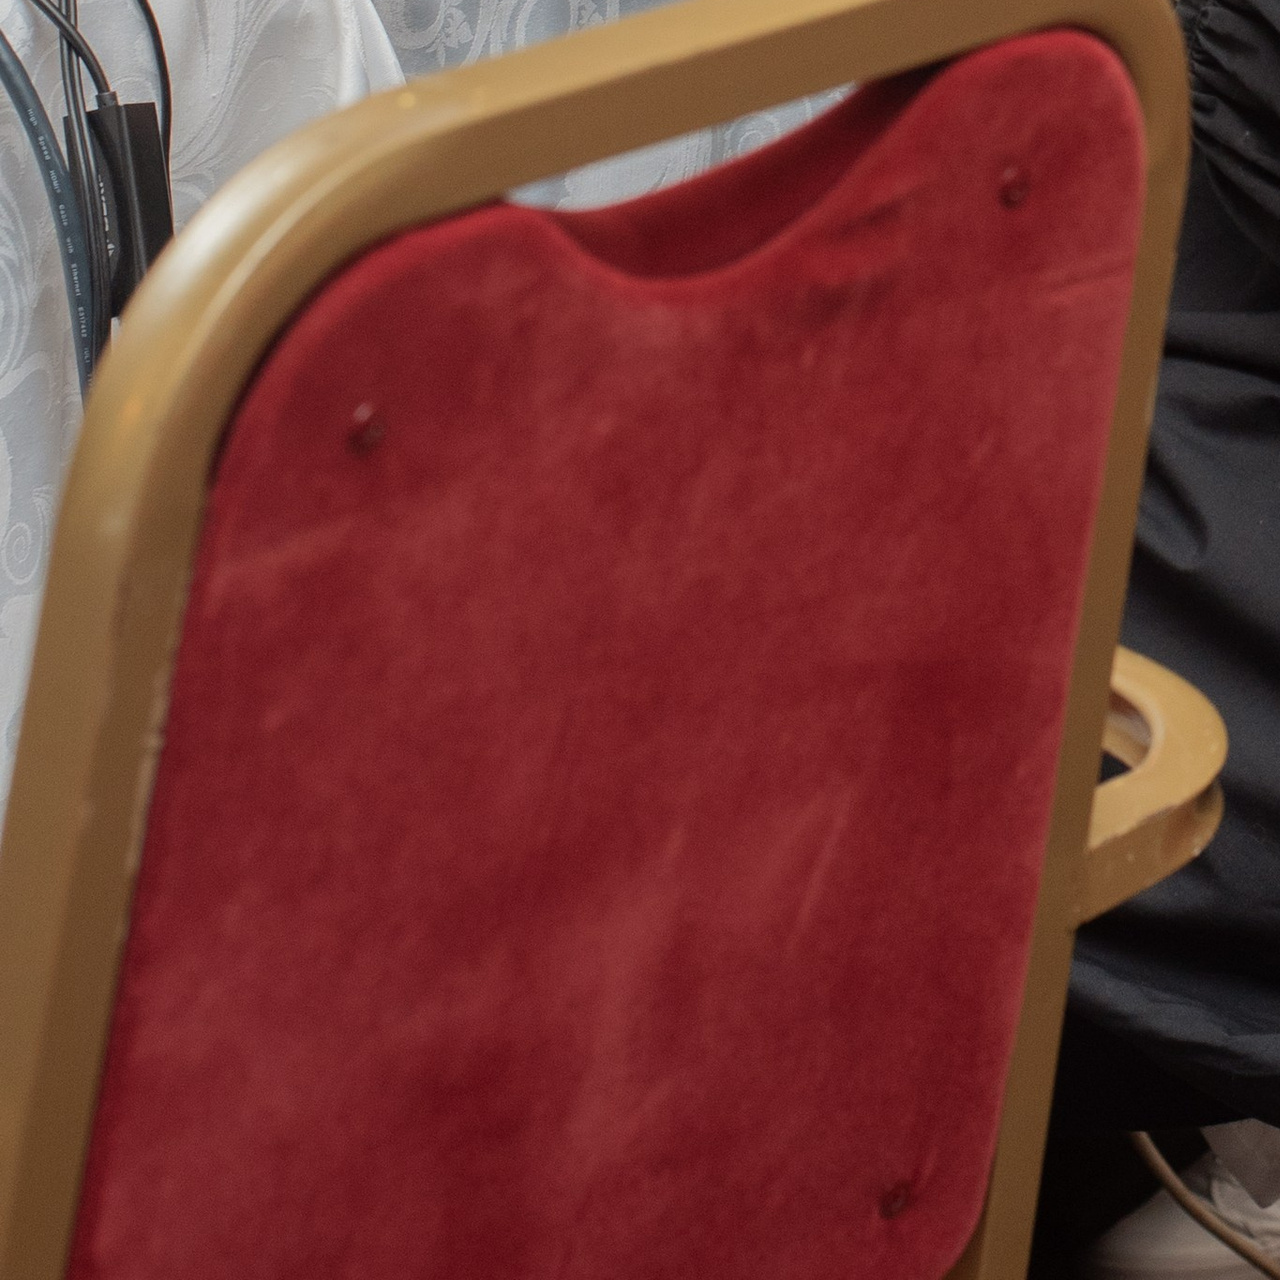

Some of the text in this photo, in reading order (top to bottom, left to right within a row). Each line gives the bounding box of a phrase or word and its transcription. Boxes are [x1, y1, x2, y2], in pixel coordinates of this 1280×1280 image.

[27, 107, 38, 127] High
[38, 135, 51, 161] Speed
[59, 203, 69, 227] Cable
[66, 236, 75, 255] with
[71, 262, 81, 297] Ethernet
